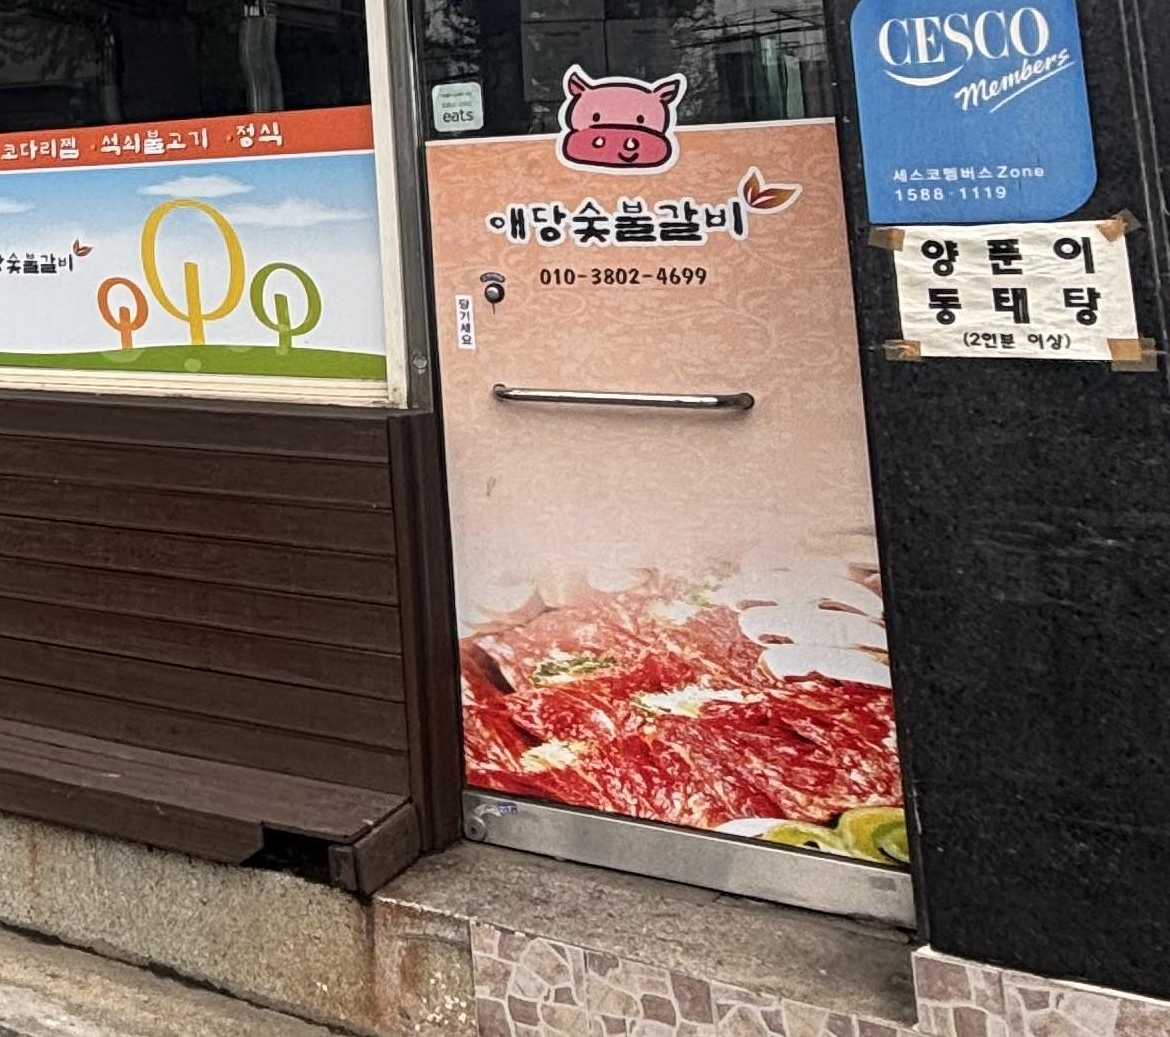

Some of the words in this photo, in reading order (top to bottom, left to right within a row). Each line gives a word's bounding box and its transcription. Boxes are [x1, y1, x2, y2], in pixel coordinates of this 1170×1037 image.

[879, 7, 1049, 66] CESCO
[954, 48, 1070, 111] Members
[442, 108, 474, 123] eats
[1, 136, 80, 160] 코다리찜
[100, 127, 209, 156] 석쇠불고기
[236, 121, 283, 148] 정식
[540, 267, 708, 286] 010-3802-4699
[458, 298, 473, 345] 당기세요
[928, 287, 1102, 326] 동태탕
[963, 331, 1015, 349] (2인분
[1027, 332, 1071, 350] 이상)
